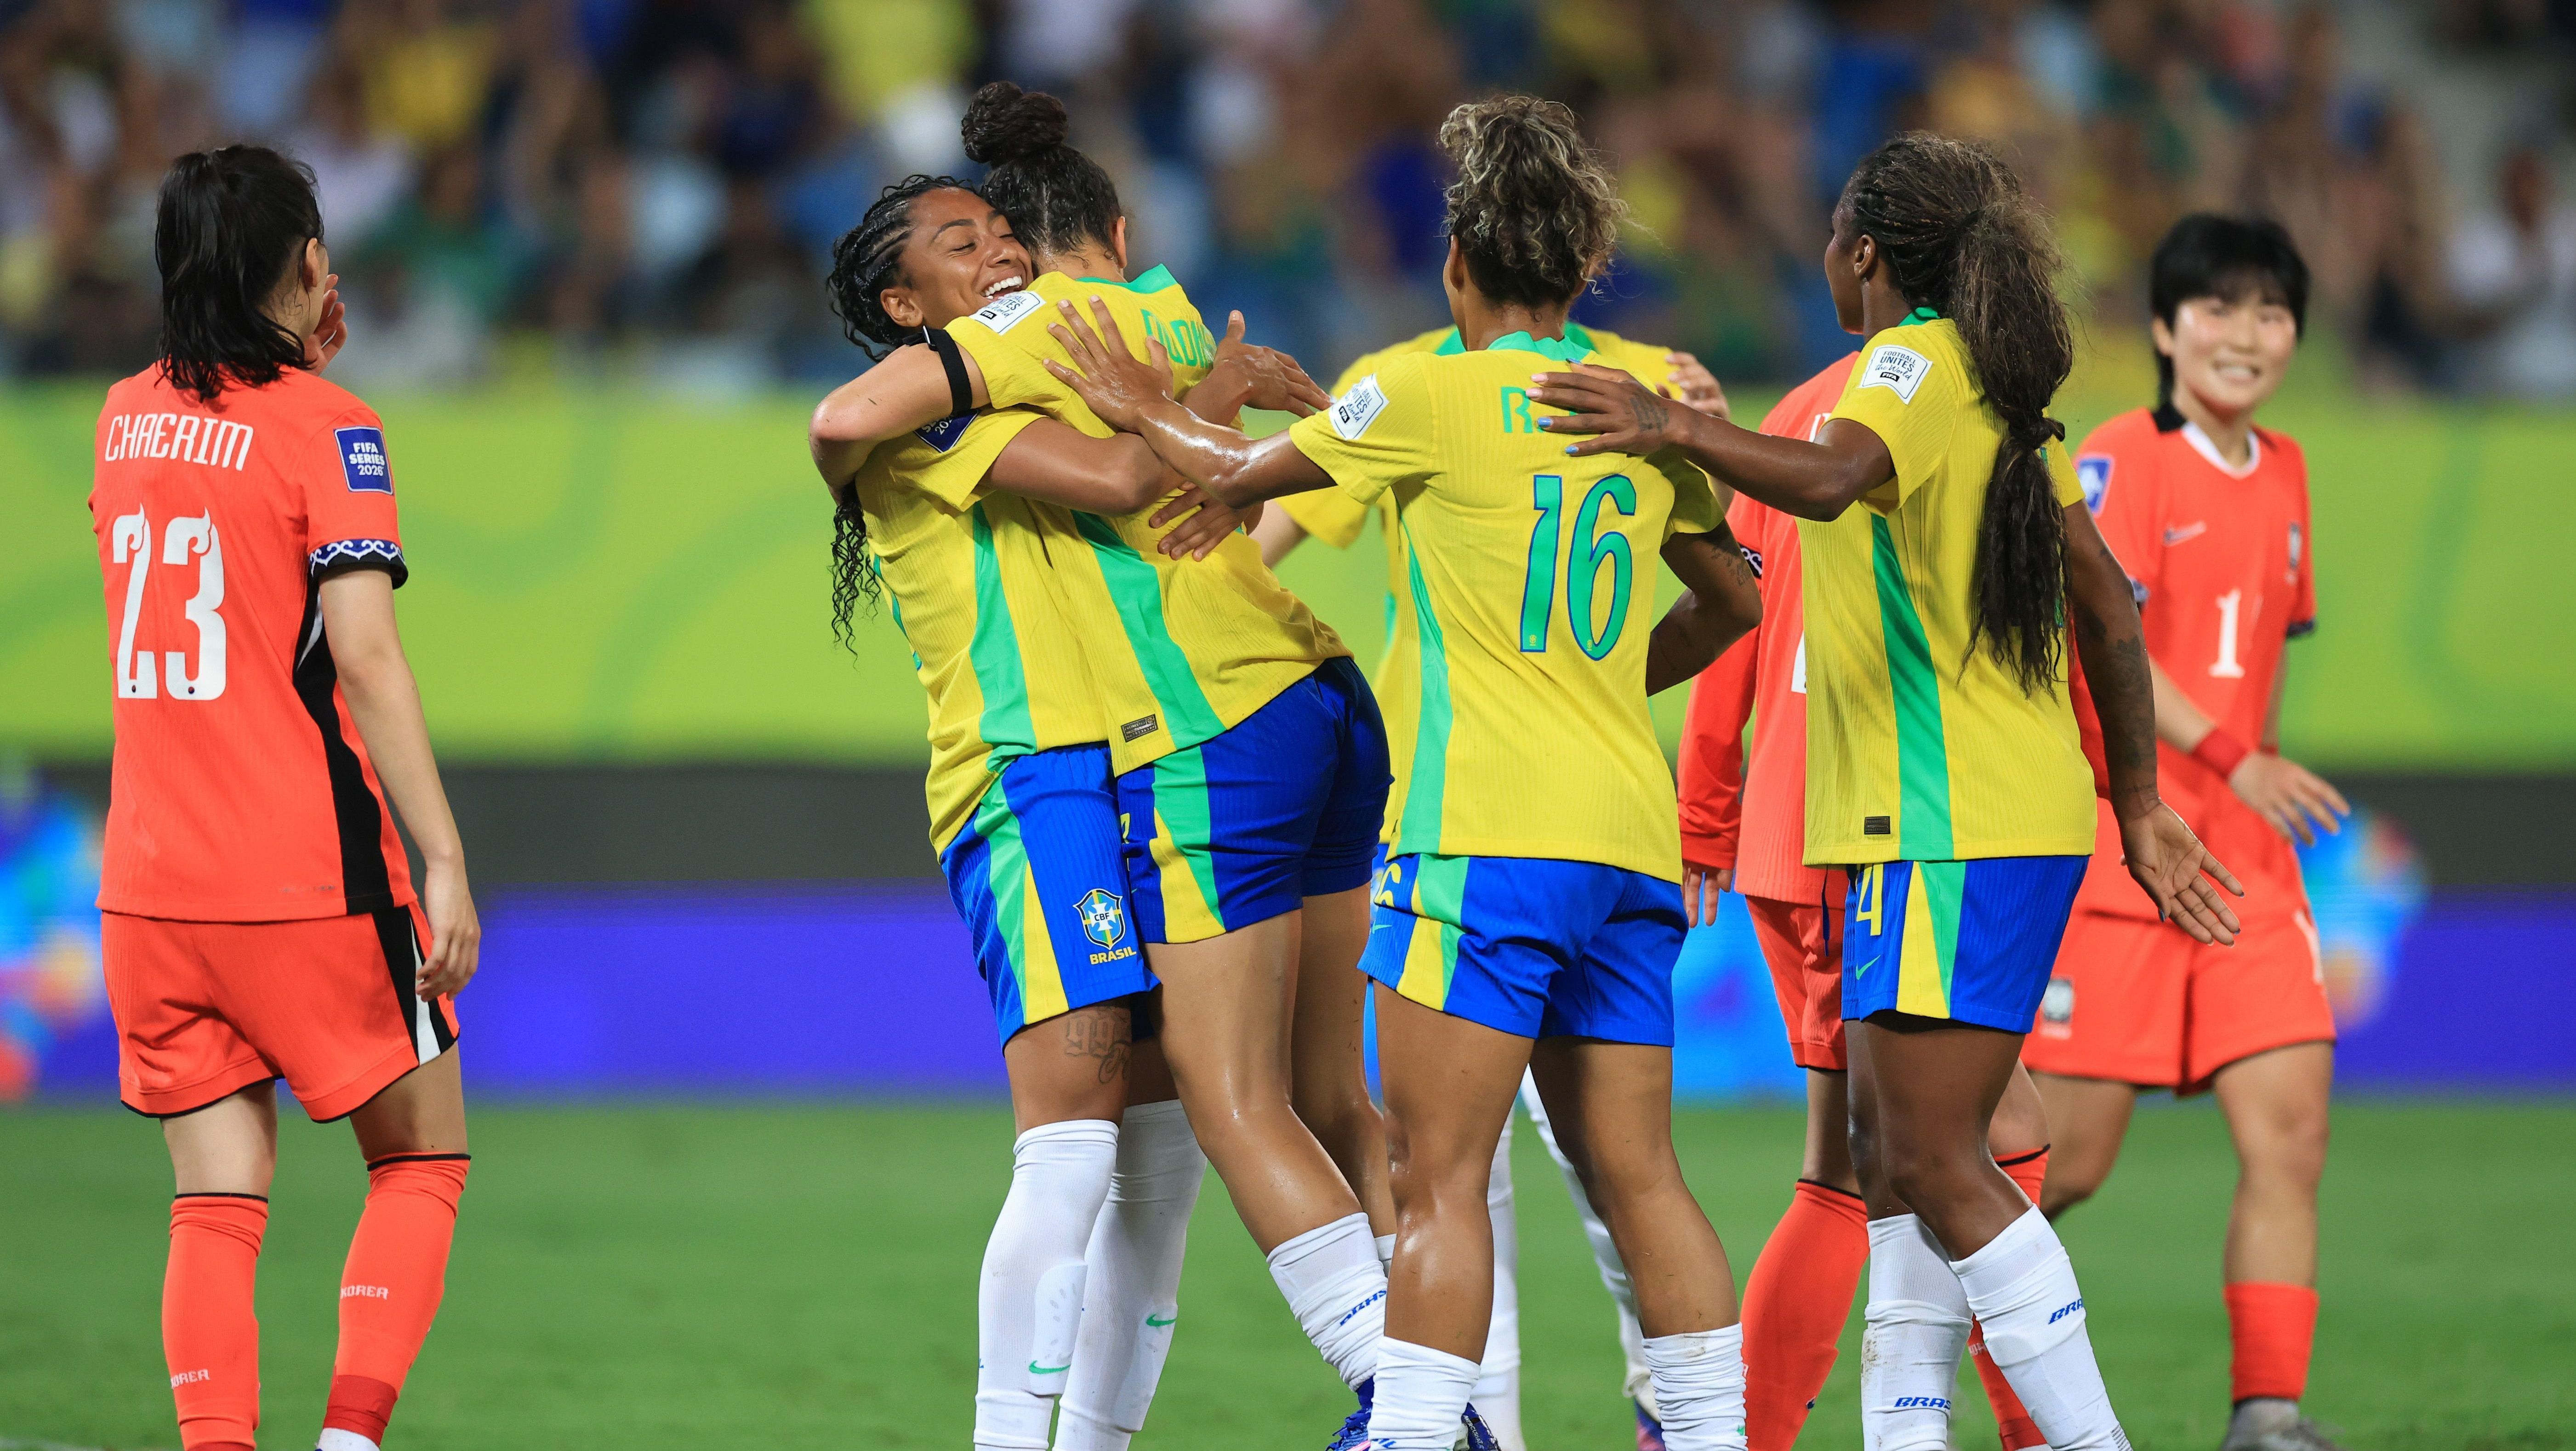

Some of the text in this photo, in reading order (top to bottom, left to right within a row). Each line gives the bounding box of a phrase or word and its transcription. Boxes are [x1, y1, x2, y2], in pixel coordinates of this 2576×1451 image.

[1880, 356, 1915, 372] UNITES
[1883, 351, 1916, 365] FOOTBALL
[1881, 372, 1898, 381] FIFA
[1888, 364, 1912, 381] World
[105, 413, 254, 471] CHAERIM
[353, 442, 379, 453] FIFA
[348, 453, 385, 466] SERIES
[357, 464, 384, 477] 2026
[1520, 474, 1636, 661] 16
[112, 502, 227, 701] 23
[2208, 587, 2245, 678] 1
[1094, 912, 1110, 922] CBF
[1089, 946, 1137, 965] BRASIL
